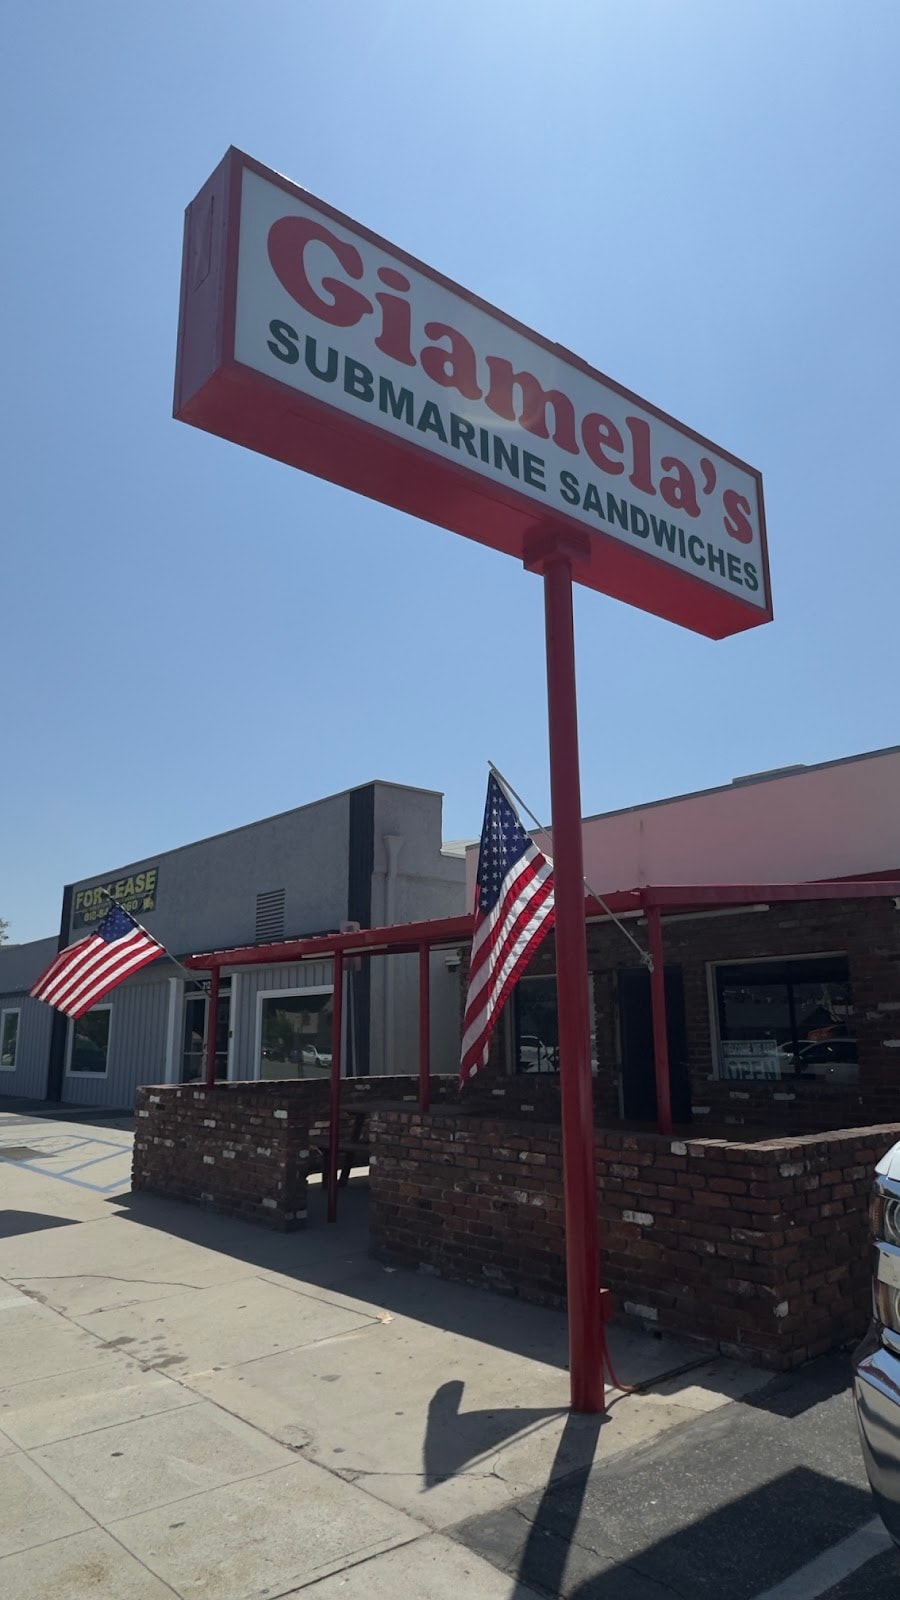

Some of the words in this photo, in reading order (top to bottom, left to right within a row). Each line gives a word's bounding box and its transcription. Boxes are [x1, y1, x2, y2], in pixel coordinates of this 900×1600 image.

[267, 215, 753, 544] Giamela's
[267, 319, 547, 493] SUBMARINE
[559, 470, 759, 592] SANDWICHES
[75, 887, 103, 910] FOR
[107, 869, 157, 899] LEASE
[727, 1060, 777, 1081] OPEN
